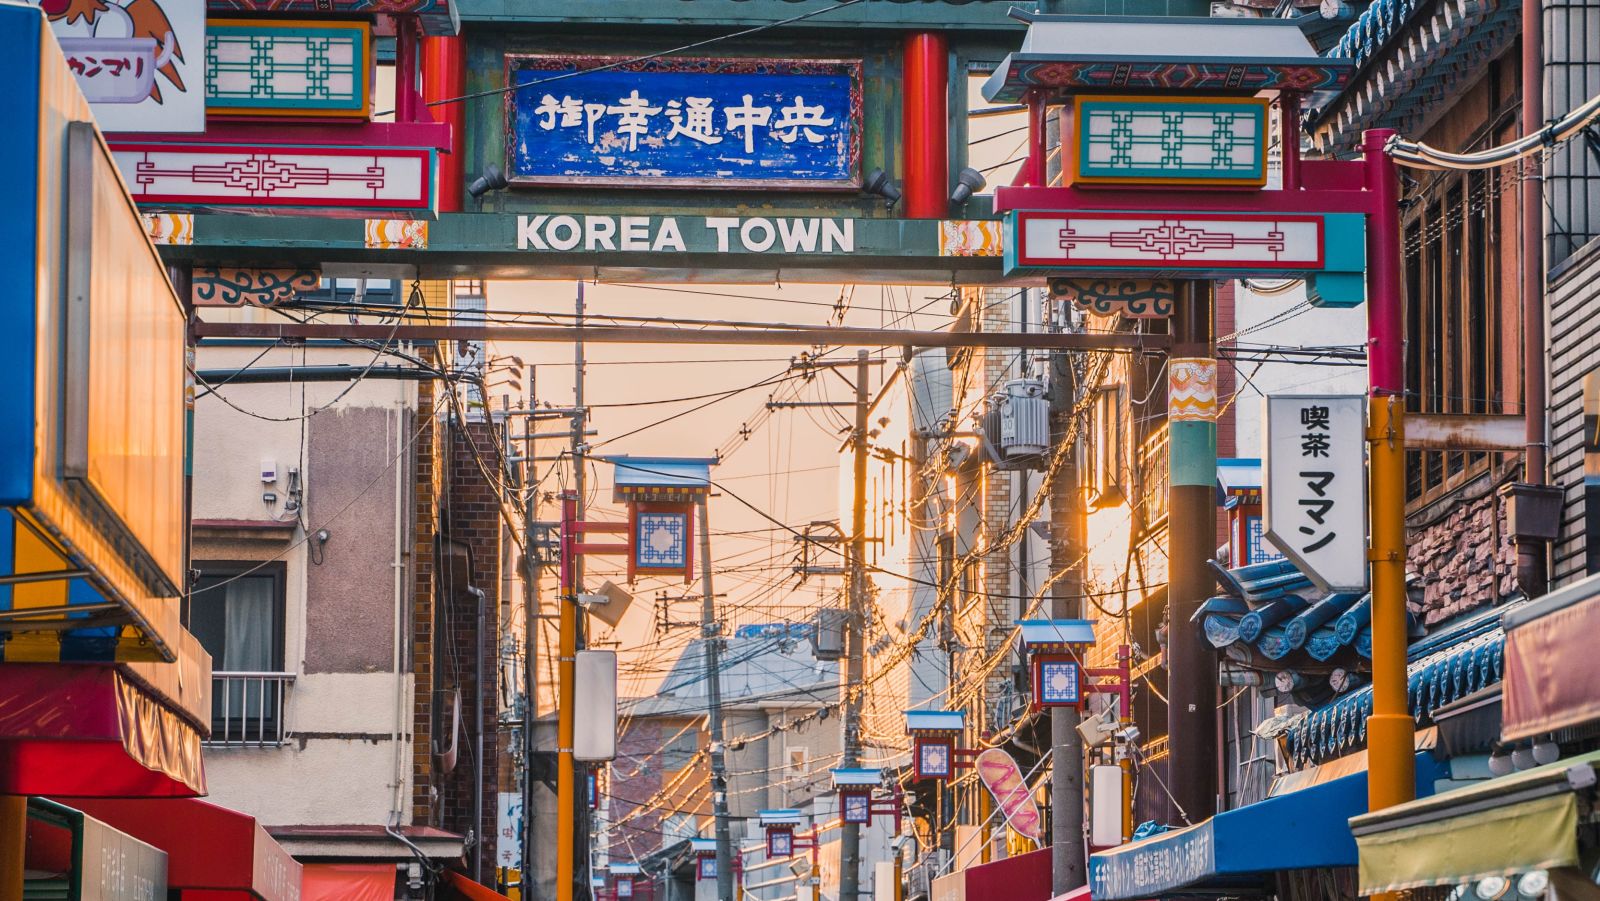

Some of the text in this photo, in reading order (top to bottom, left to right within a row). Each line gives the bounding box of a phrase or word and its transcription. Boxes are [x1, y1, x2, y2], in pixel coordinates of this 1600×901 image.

[534, 89, 834, 154] 御幸通中央
[517, 214, 854, 253] KOREA TOWN
[1298, 405, 1336, 554] 喫茶 ママン
